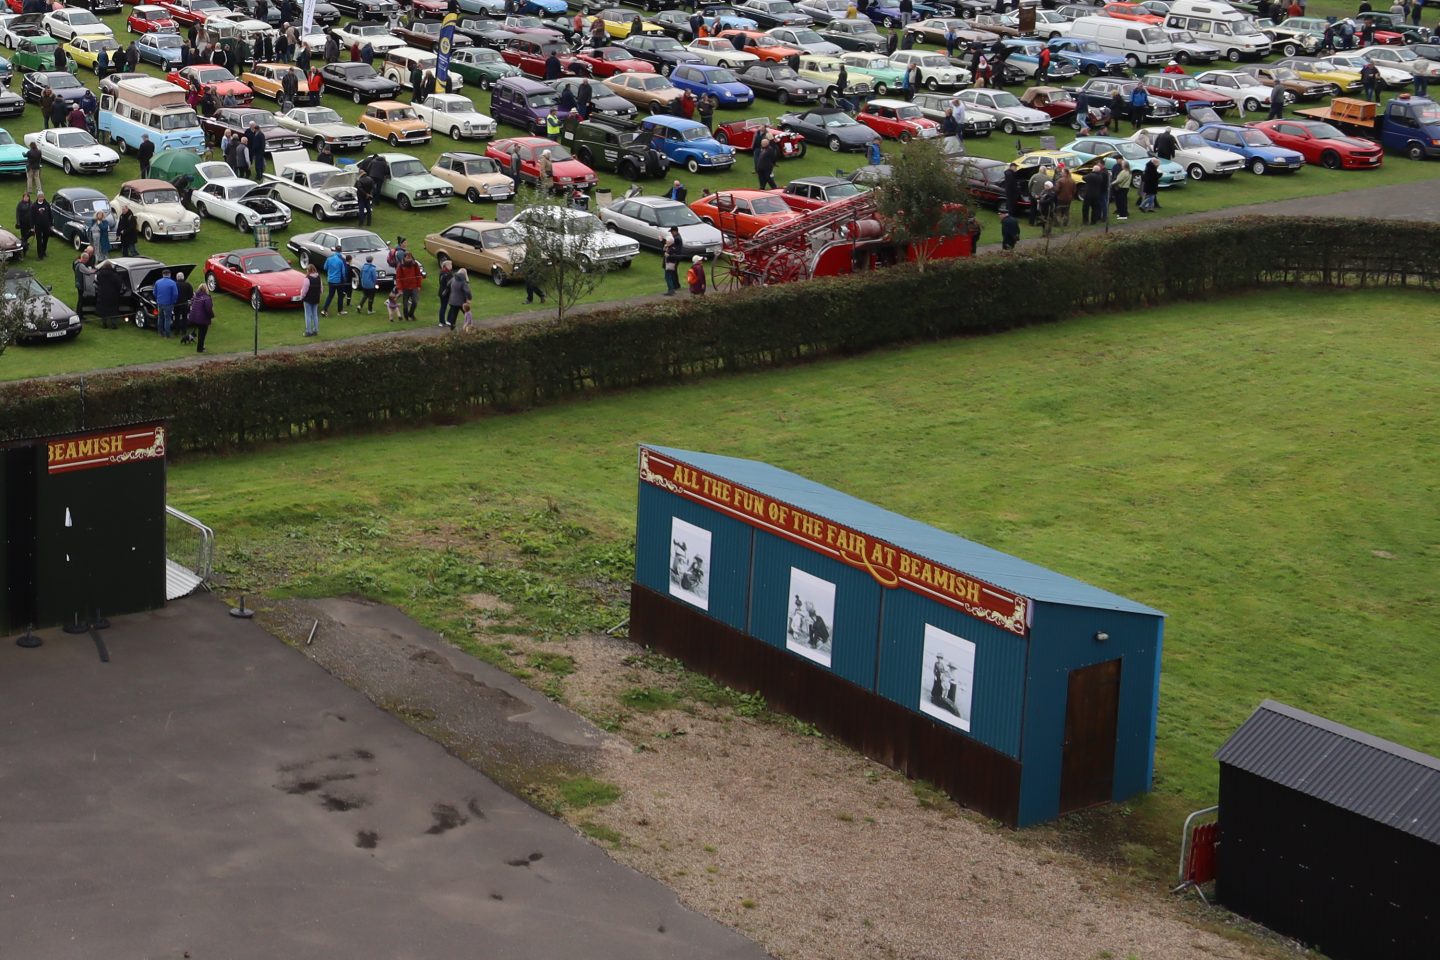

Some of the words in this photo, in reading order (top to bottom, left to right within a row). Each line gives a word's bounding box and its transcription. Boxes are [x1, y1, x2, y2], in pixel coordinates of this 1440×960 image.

[48, 435, 123, 462] BEAMISH
[673, 464, 700, 490] ALL
[702, 475, 732, 502] THE
[733, 487, 765, 517] FUN
[768, 502, 789, 525] OF
[791, 511, 824, 539] THE
[871, 542, 897, 569] AT
[899, 552, 981, 603] BEAMISH
